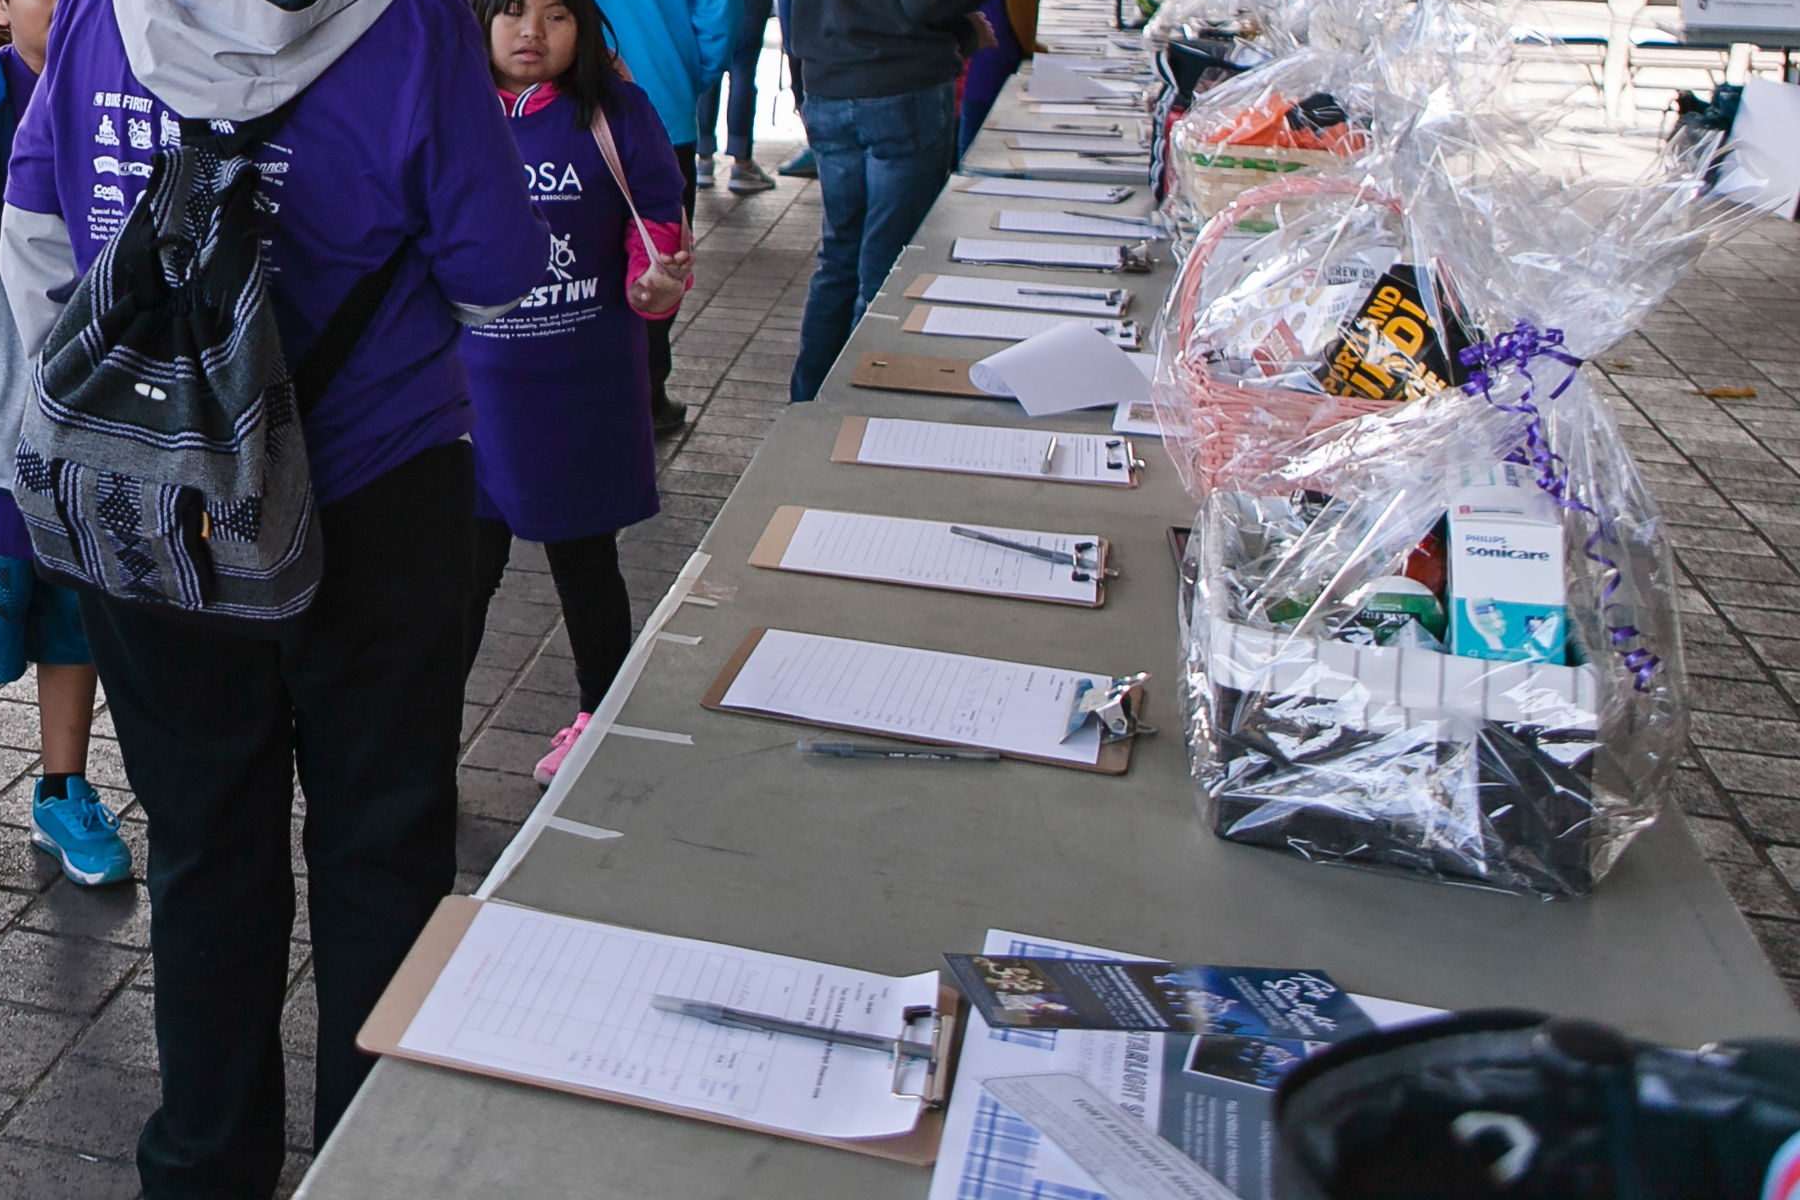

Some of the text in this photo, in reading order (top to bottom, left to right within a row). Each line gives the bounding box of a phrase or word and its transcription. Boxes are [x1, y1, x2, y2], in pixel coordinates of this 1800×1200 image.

[105, 93, 121, 108] BIKE
[566, 277, 599, 303] NW
[1465, 534, 1507, 543] PHILIPS
[1466, 546, 1550, 561] sonicare
